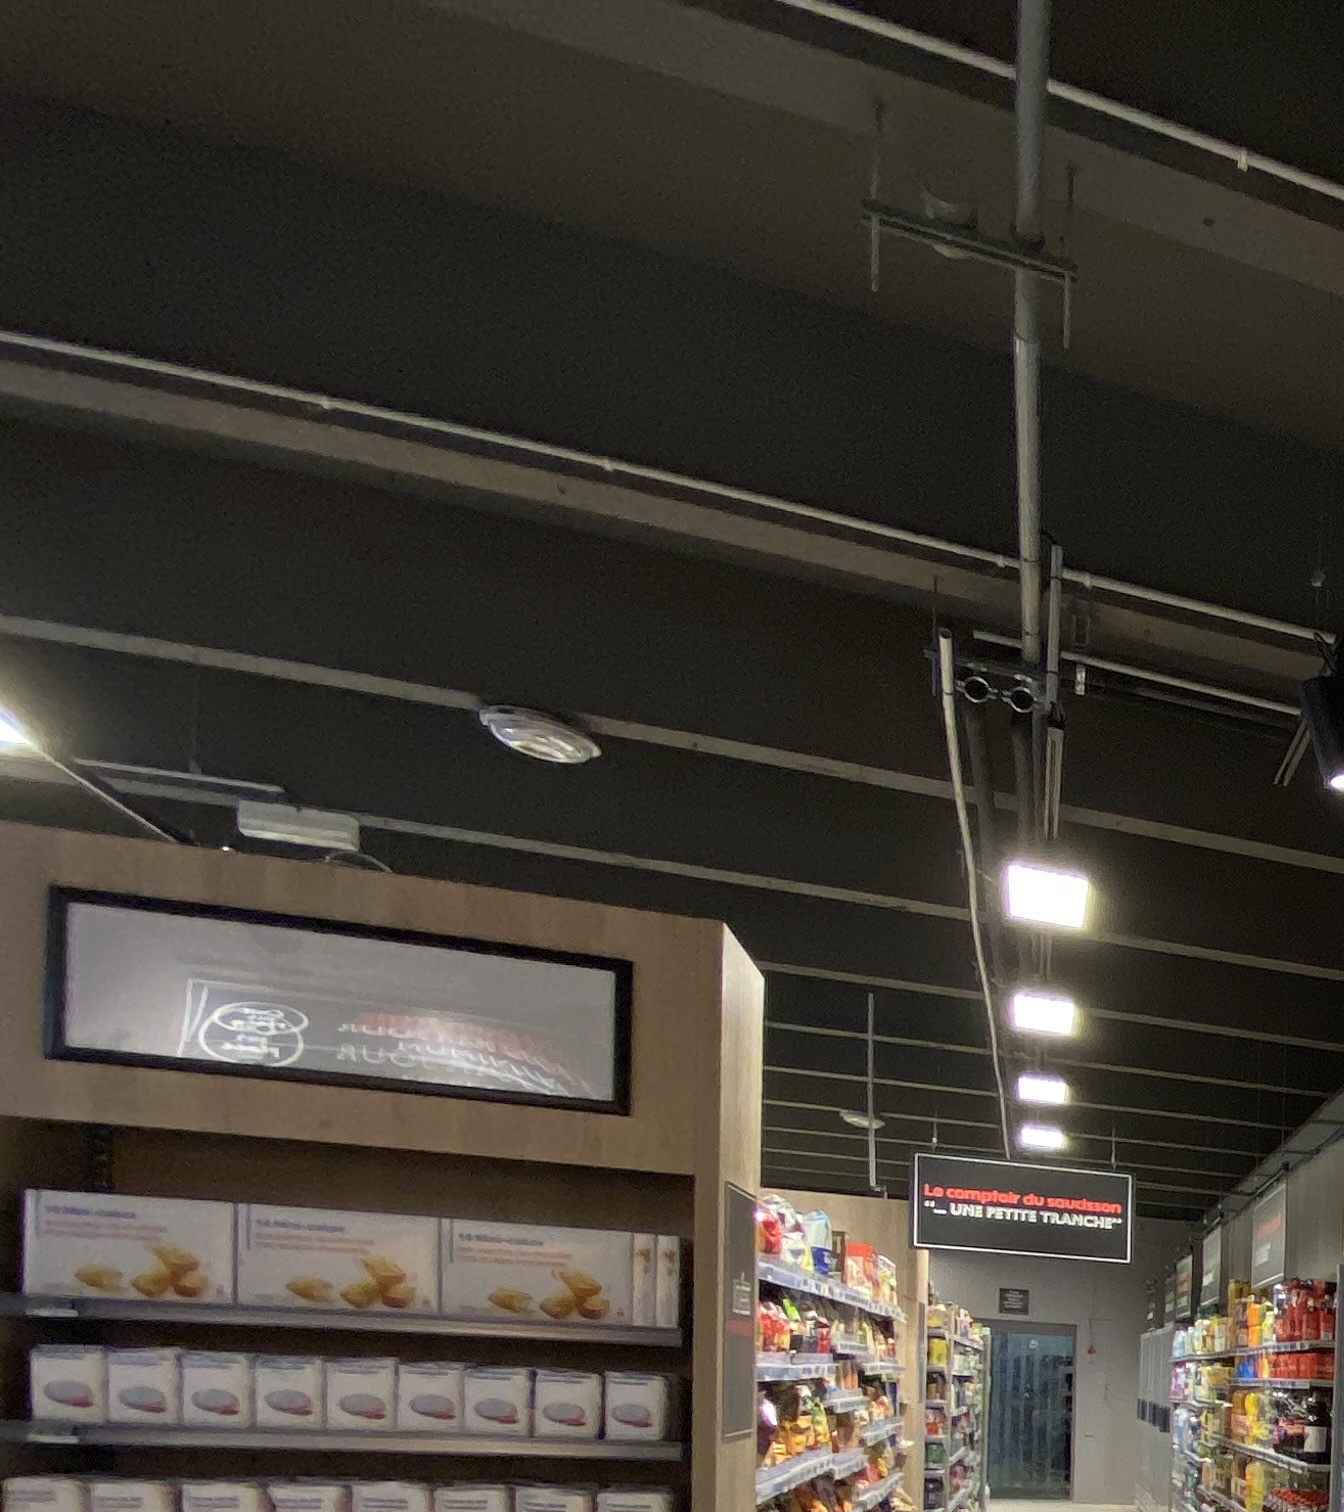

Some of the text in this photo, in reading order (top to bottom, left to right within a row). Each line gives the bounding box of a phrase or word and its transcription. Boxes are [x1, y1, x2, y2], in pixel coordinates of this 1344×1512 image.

[946, 1187, 1021, 1205] comptoir
[1023, 1193, 1045, 1206] du
[1047, 1198, 1122, 1214] saucisson
[951, 1203, 983, 1218] UNE
[986, 1206, 1037, 1222] PETITE
